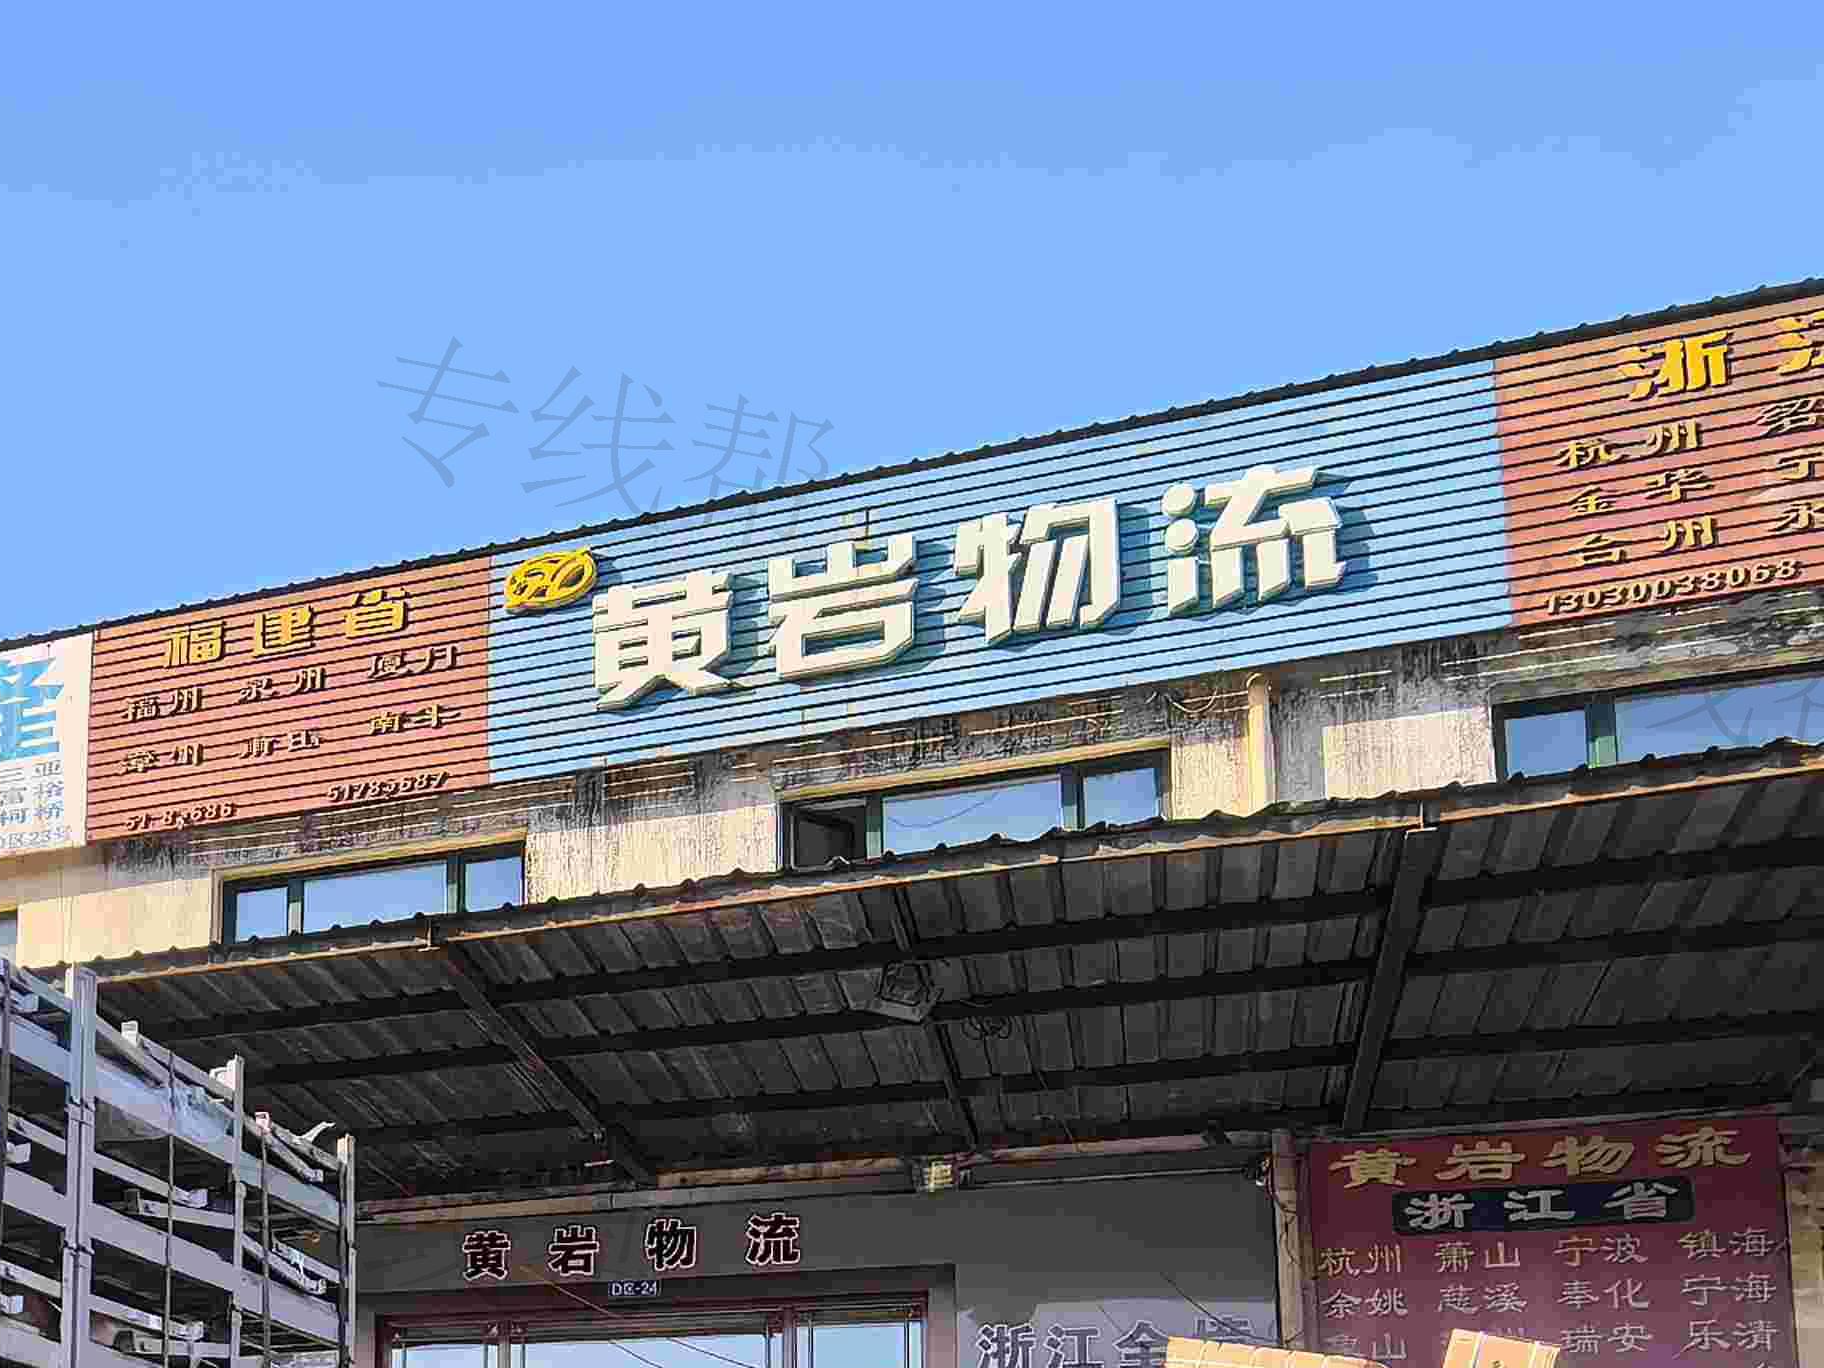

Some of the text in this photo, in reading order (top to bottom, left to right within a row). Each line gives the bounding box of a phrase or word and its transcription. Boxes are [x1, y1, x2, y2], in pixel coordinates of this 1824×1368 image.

[1552, 420, 1703, 468] 杭州
[1567, 515, 1718, 567] 台州
[590, 465, 1346, 712] 黄岩物流
[162, 589, 409, 668] 福建省
[121, 686, 203, 722] 福州
[1329, 1126, 1753, 1189] 黄岩物流
[1403, 1181, 1680, 1230] 浙江省
[461, 1211, 803, 1281] 黄岩物流
[1318, 1227, 1774, 1278] 杭州 萧山 宁波 镇海
[1320, 1288, 1408, 1320] 余姚
[1556, 1279, 1651, 1311] 奉化
[1679, 1272, 1777, 1306] 宁海
[1559, 1325, 1653, 1357] 瑞安
[1673, 1320, 1781, 1360] 乐清
